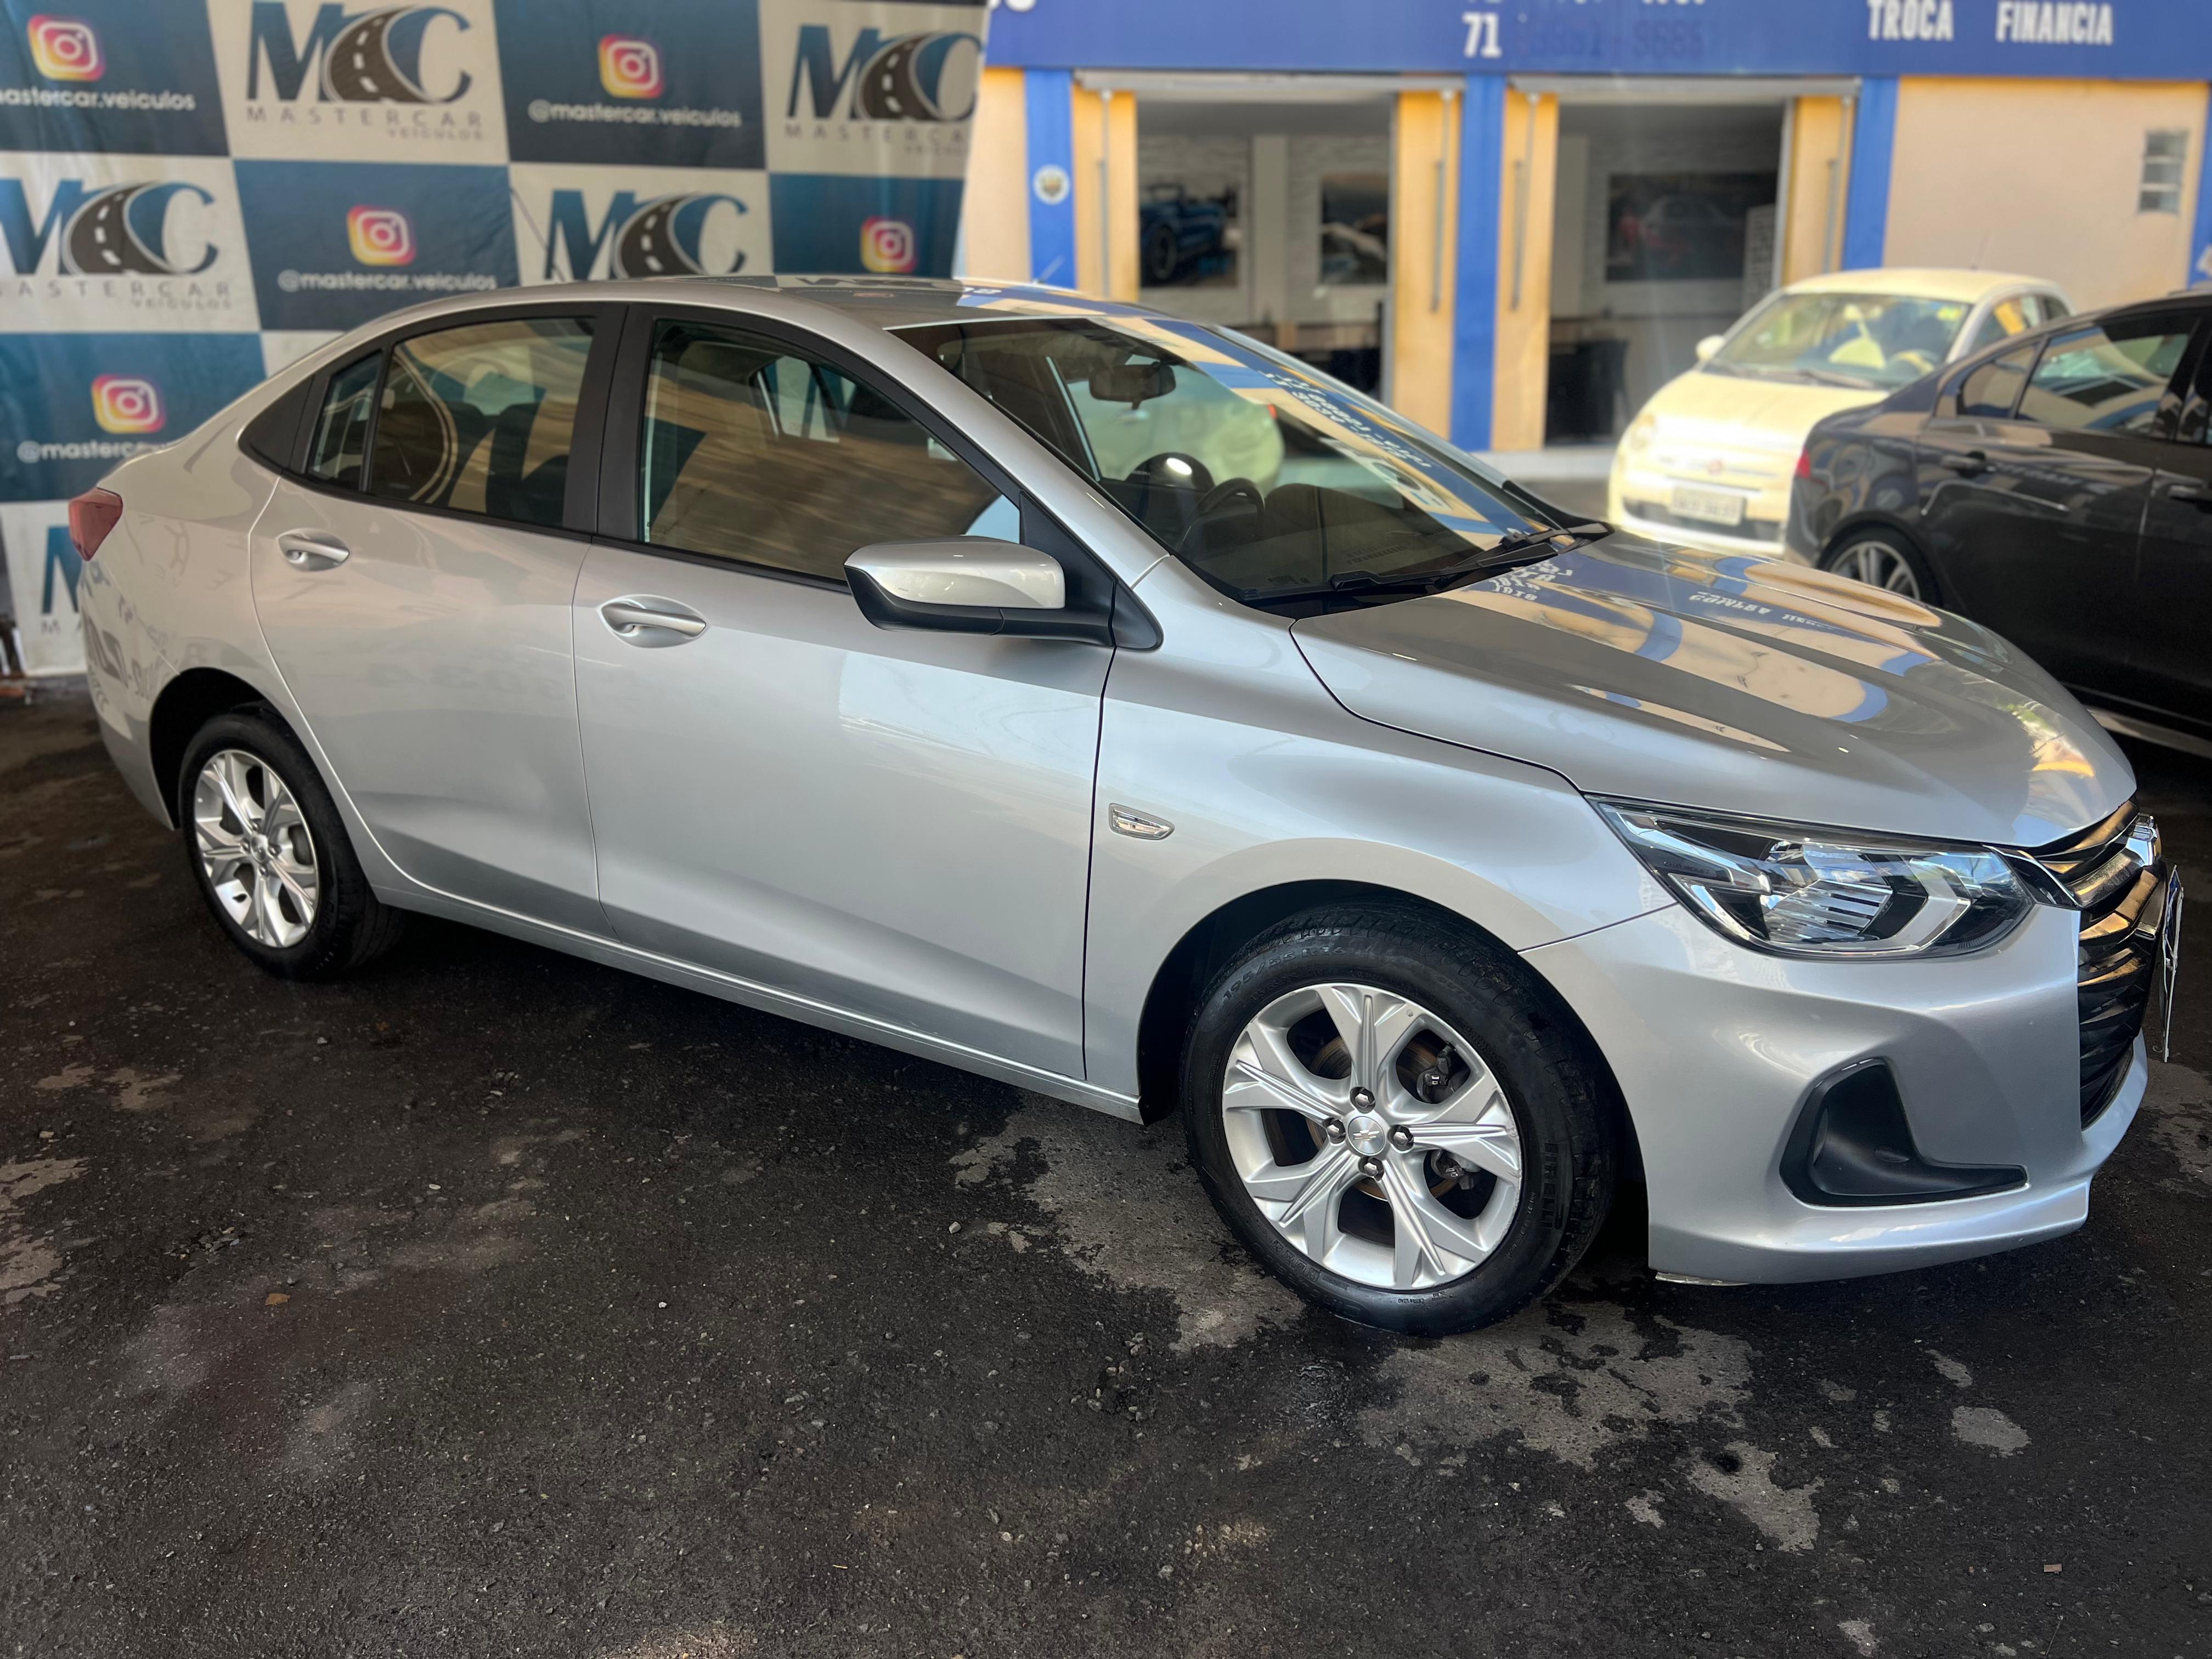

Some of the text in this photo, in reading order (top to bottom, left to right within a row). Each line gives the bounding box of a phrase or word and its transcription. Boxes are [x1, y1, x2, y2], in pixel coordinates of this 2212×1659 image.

[1870, 0, 2114, 45] TROCA FINANCIA
[1462, 12, 1502, 58] 71
[0, 86, 196, 110] astercar.veiculos
[246, 106, 483, 128] MASTERCAR
[0, 280, 231, 299] ASTERCAR
